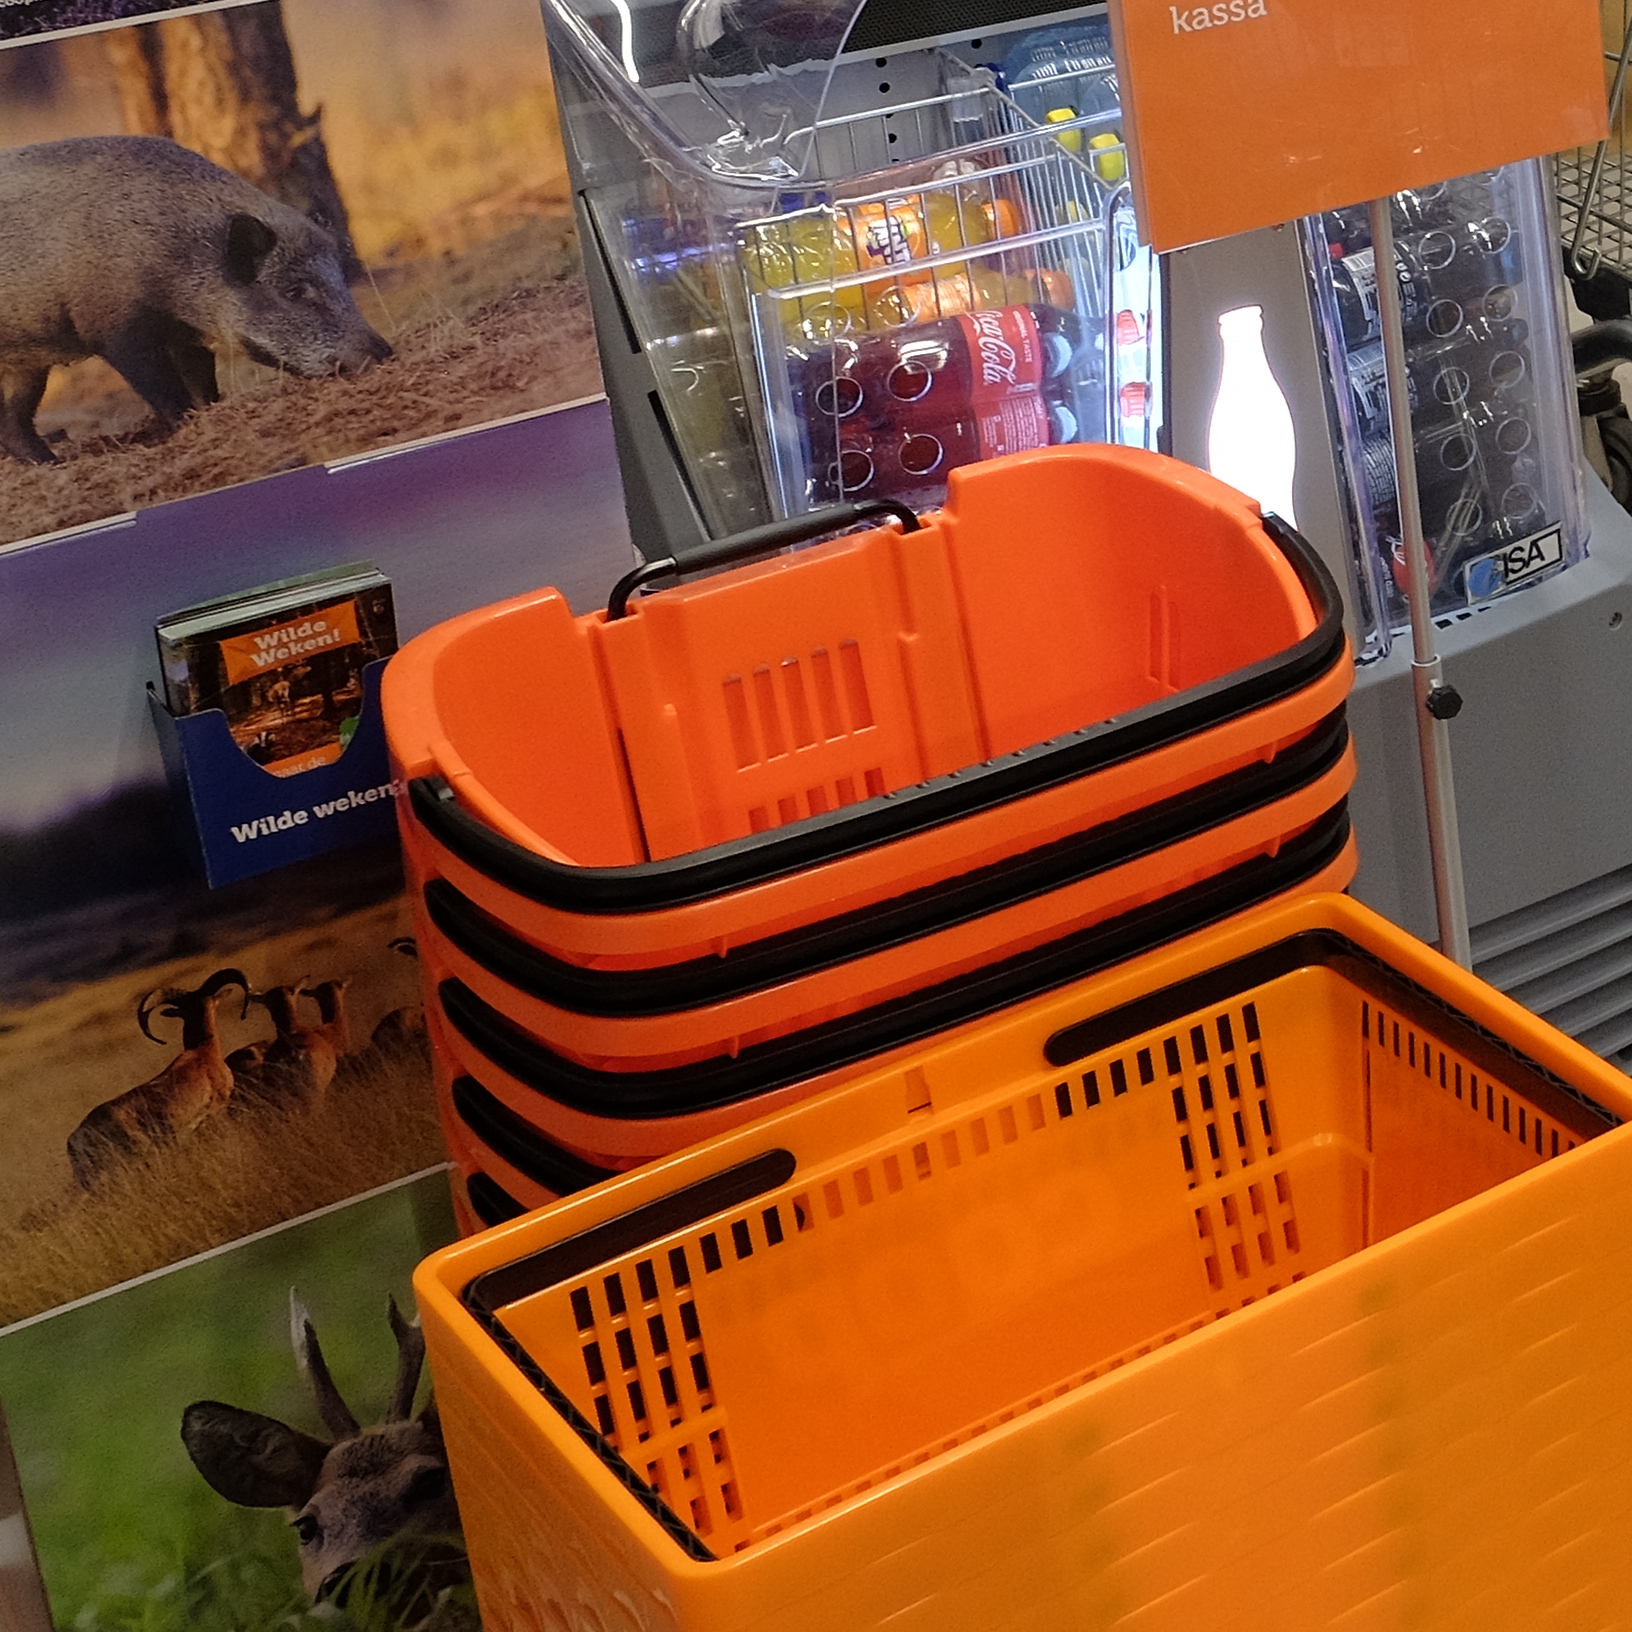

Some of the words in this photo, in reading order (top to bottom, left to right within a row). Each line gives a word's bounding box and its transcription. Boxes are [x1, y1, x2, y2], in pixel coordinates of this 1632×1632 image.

[1022, 339, 1034, 364] TASTE
[1503, 539, 1548, 579] ISA
[250, 628, 342, 668] Weken!
[254, 619, 328, 651] Wilde
[230, 810, 309, 844] Wilde
